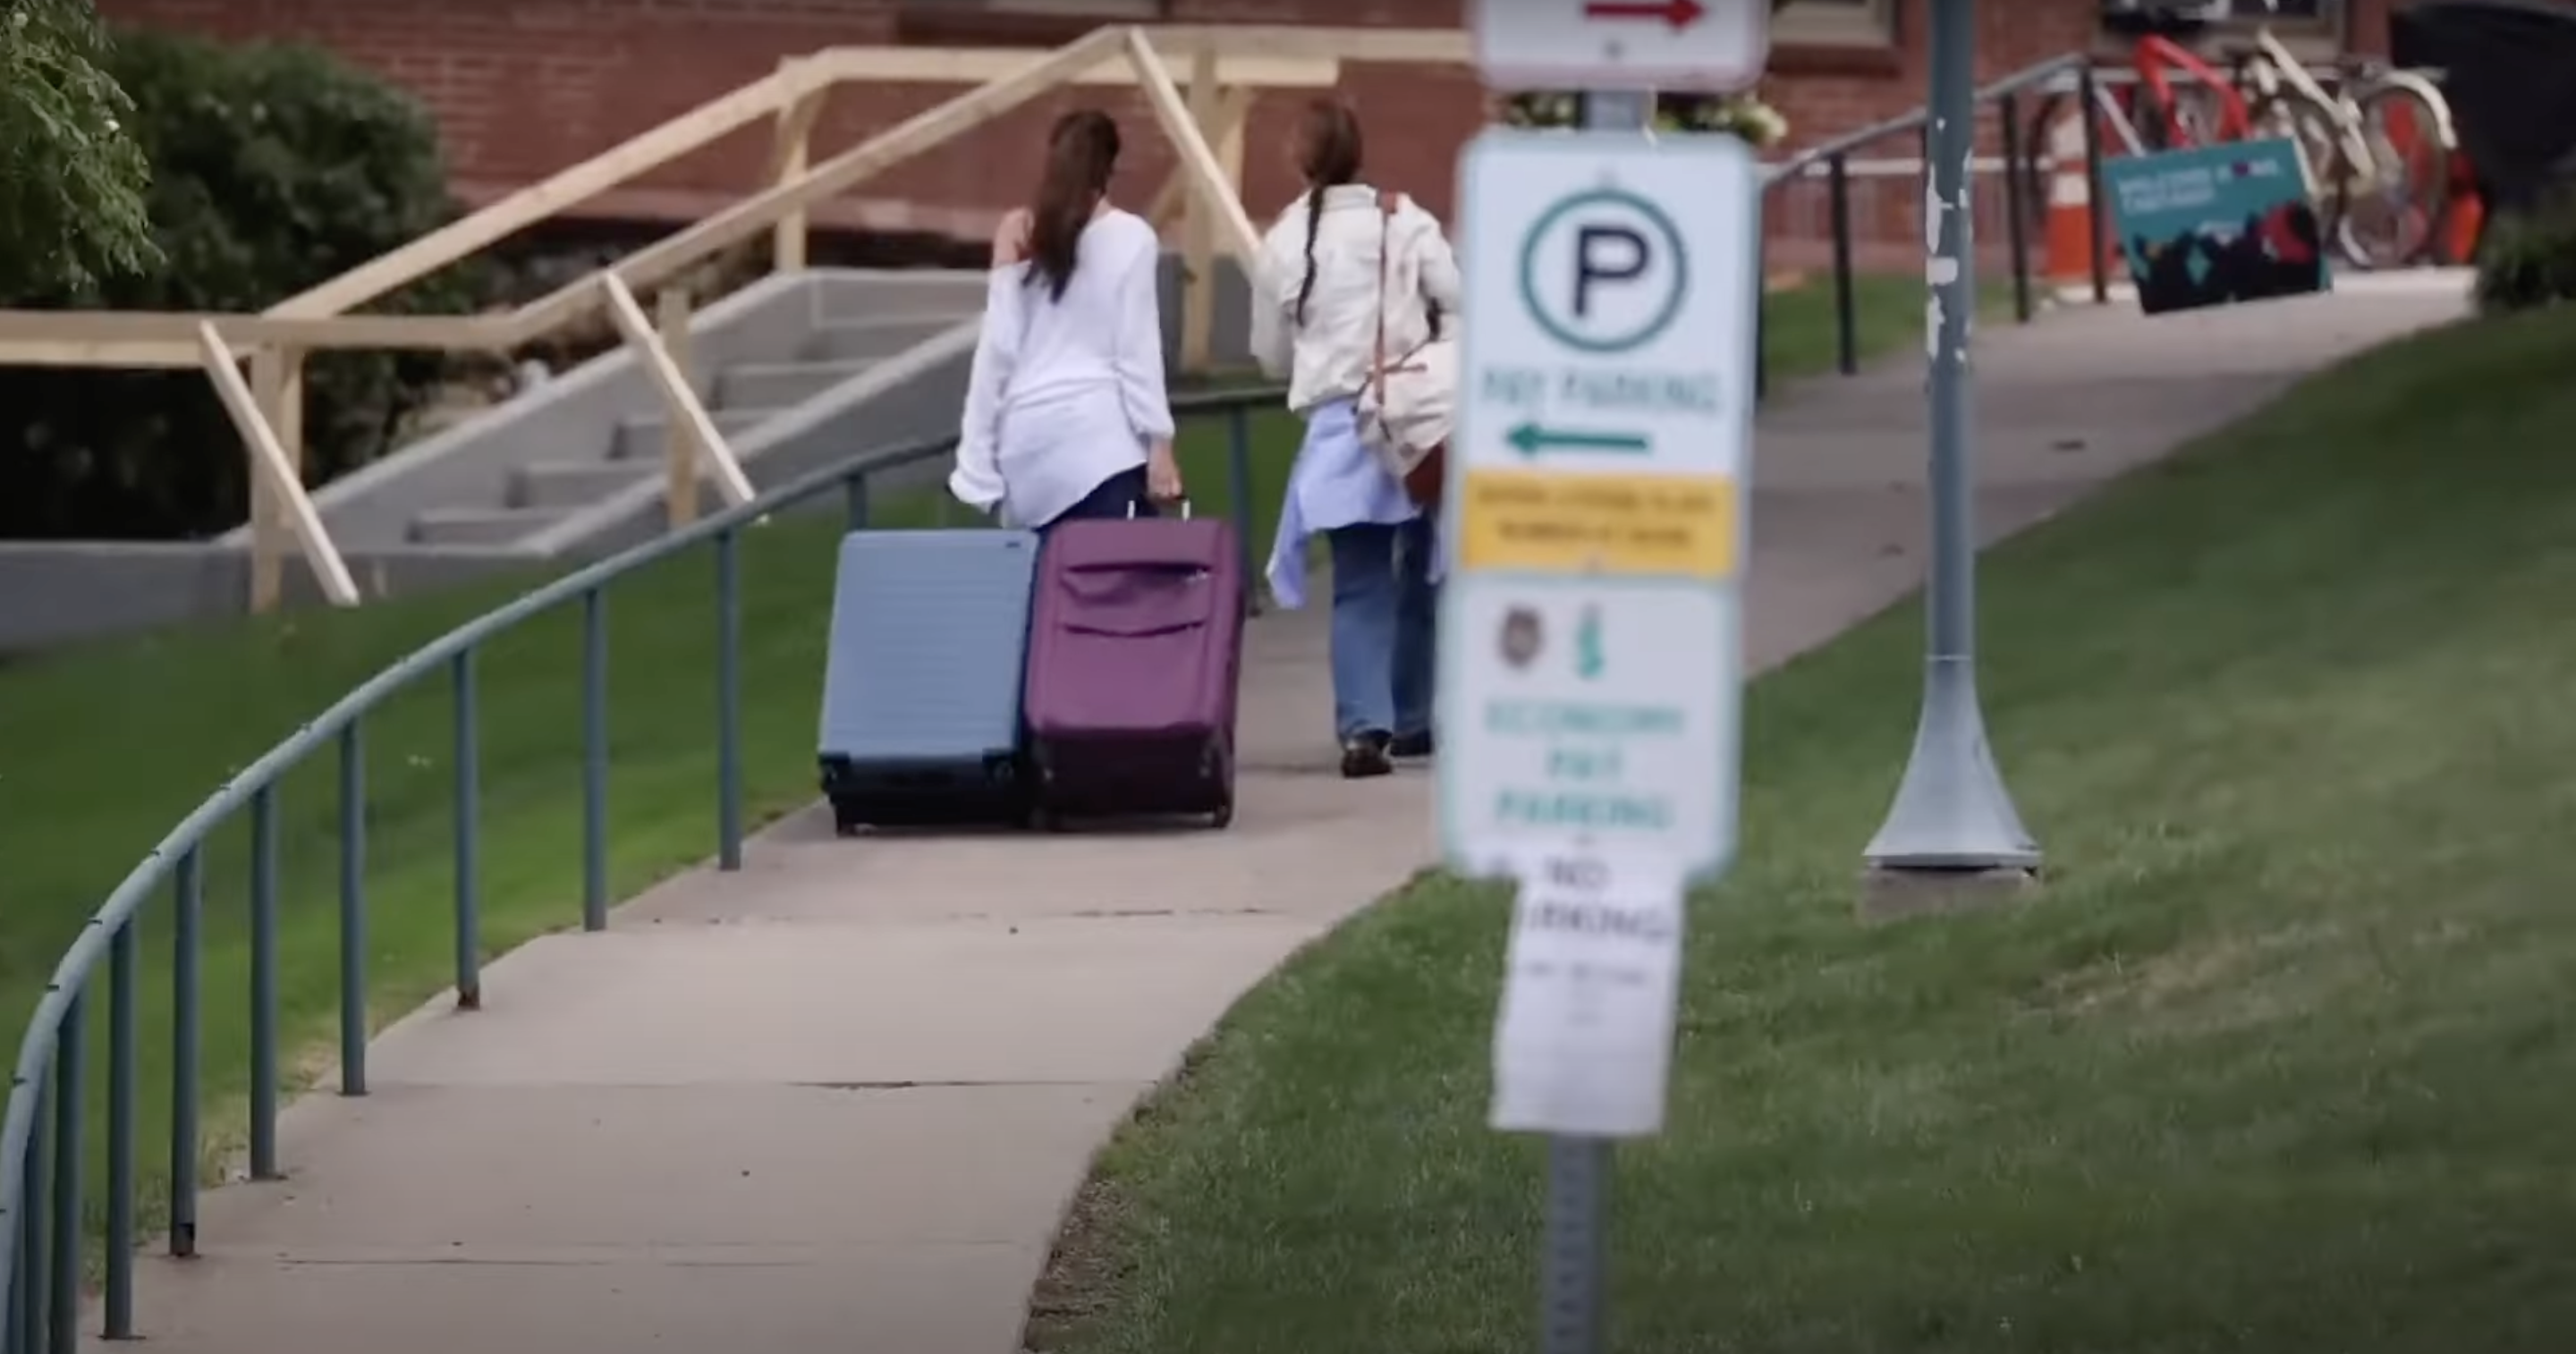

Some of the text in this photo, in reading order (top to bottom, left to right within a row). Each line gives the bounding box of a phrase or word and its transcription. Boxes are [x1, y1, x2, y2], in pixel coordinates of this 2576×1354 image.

[1572, 224, 1651, 317] P
[1559, 368, 1722, 414] PARKING
[1484, 701, 1685, 737] ECONOMY
[1494, 788, 1677, 831] PARKING
[1544, 856, 1613, 890] NO
